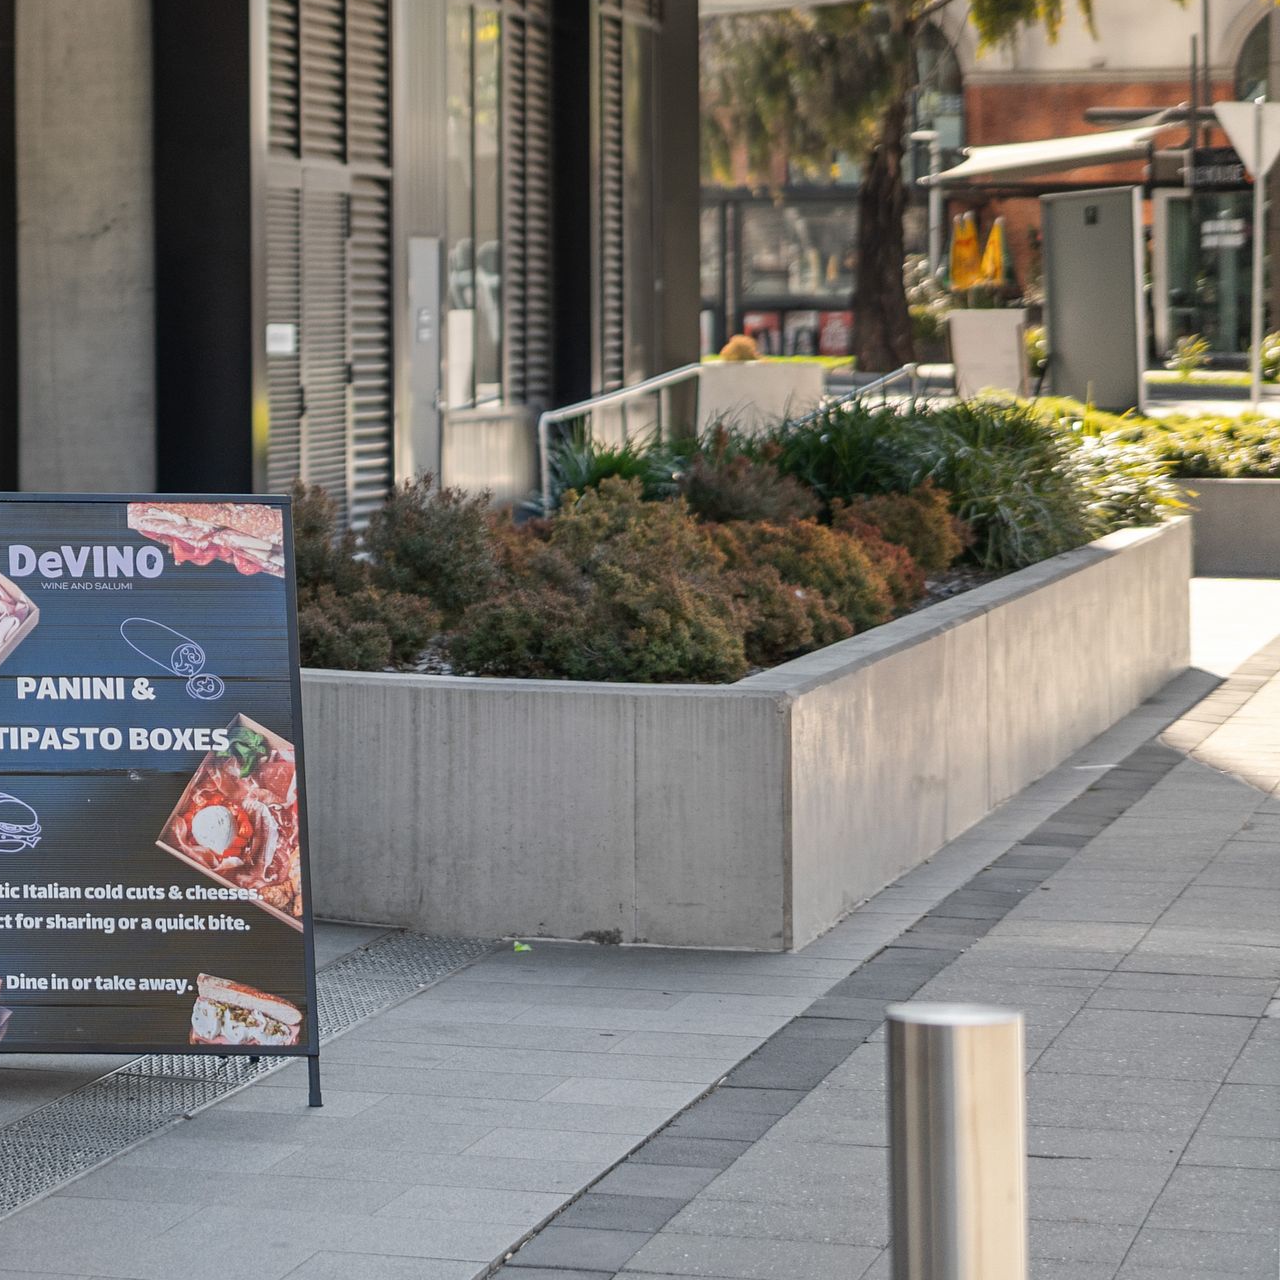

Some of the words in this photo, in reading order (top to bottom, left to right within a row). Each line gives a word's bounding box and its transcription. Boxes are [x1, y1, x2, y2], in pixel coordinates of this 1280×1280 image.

[8, 544, 164, 579] DeVINO
[41, 582, 69, 590] WINE
[70, 582, 93, 590] AND
[94, 582, 133, 590] SALUMI
[16, 676, 125, 700] PANINI
[132, 677, 156, 701] &
[128, 727, 230, 751] BOXES
[23, 882, 82, 900] Italian
[84, 883, 123, 900] cold
[126, 885, 166, 901] cuts
[169, 885, 183, 901] &
[185, 885, 264, 901] cheeses.
[15, 913, 43, 929] for
[45, 913, 116, 934] sharing
[118, 917, 138, 930] or
[140, 918, 153, 930] a
[155, 914, 205, 933] quick
[208, 914, 251, 931] bite.
[6, 973, 49, 990] Dine
[51, 973, 70, 990] in
[71, 977, 92, 990] or
[94, 974, 136, 991] take
[138, 977, 193, 995] away.
